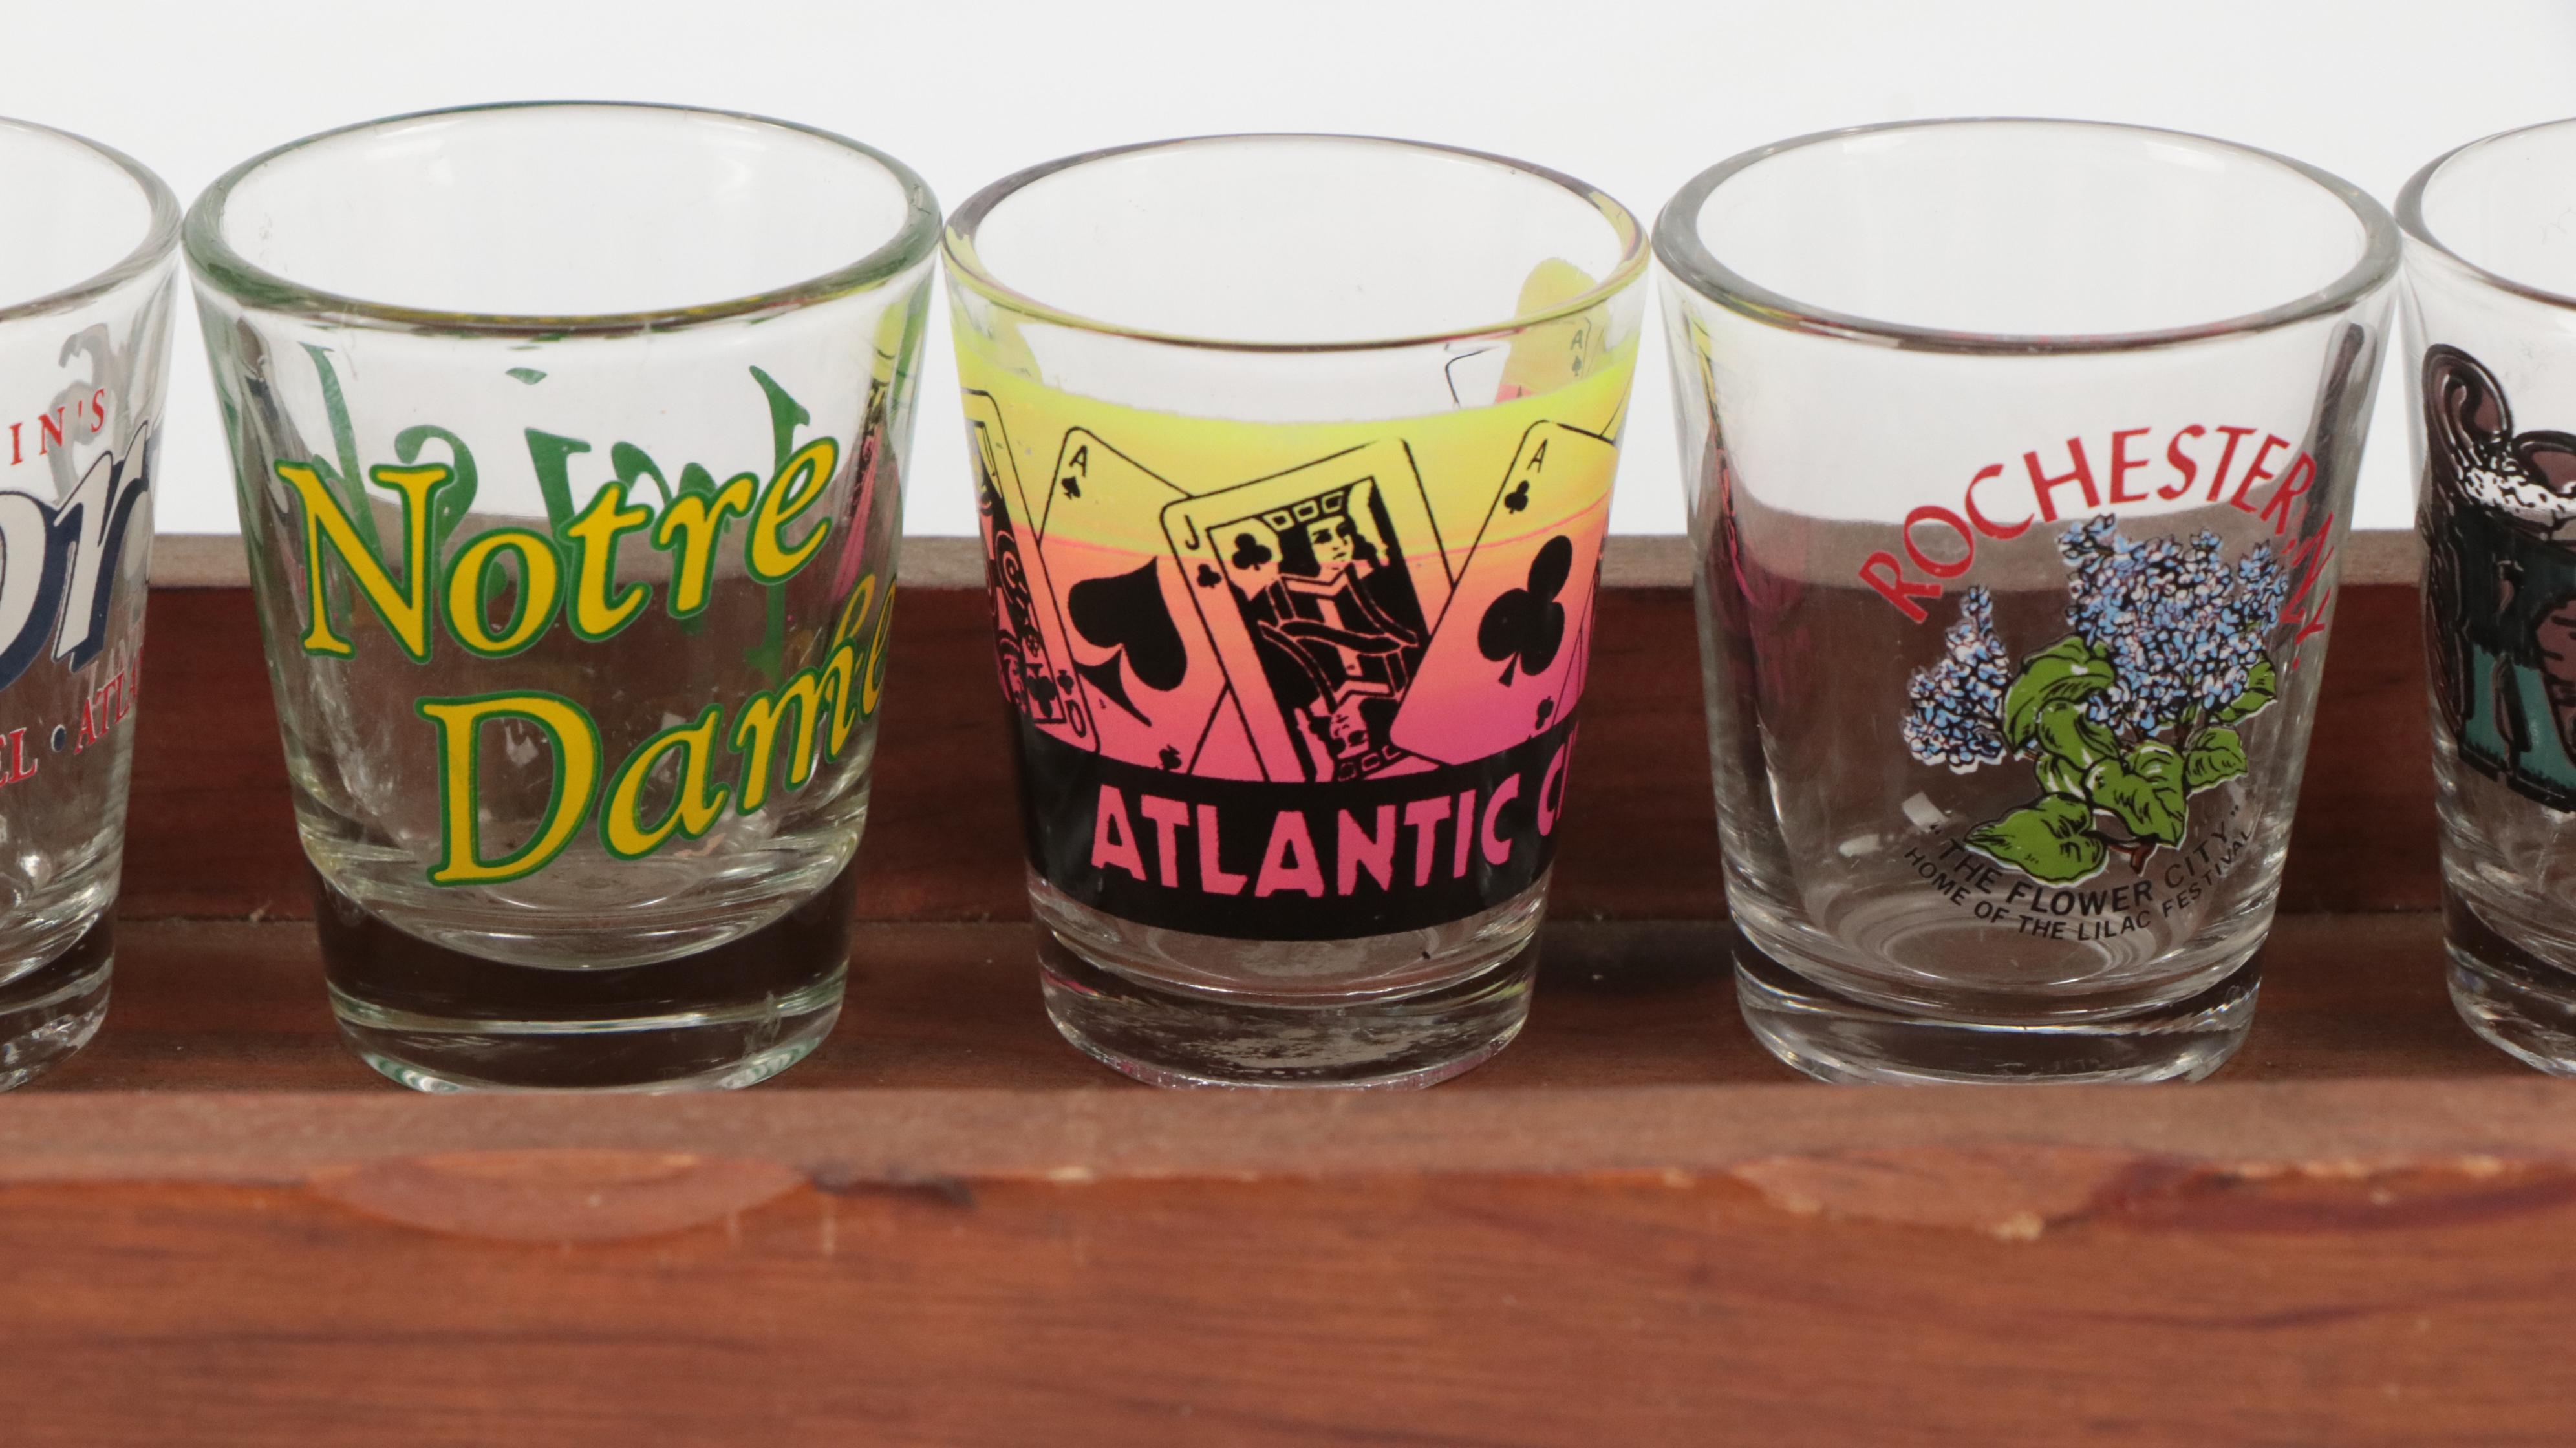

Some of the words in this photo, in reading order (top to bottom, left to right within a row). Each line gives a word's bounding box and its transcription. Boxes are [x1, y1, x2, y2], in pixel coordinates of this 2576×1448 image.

[1068, 444, 1088, 478] A
[1527, 438, 1548, 474] A
[274, 436, 839, 663] Notre
[1183, 513, 1200, 551] J
[414, 572, 897, 886] Dame
[1091, 772, 1520, 897] ATLANTIC
[1905, 847, 1971, 906] HOME
[1974, 900, 2010, 924] OF
[2019, 915, 2066, 940] THE
[2077, 910, 2151, 941] LILAC
[2162, 830, 2253, 918] FESTIVAL
[2006, 880, 2153, 917] FLOWER
